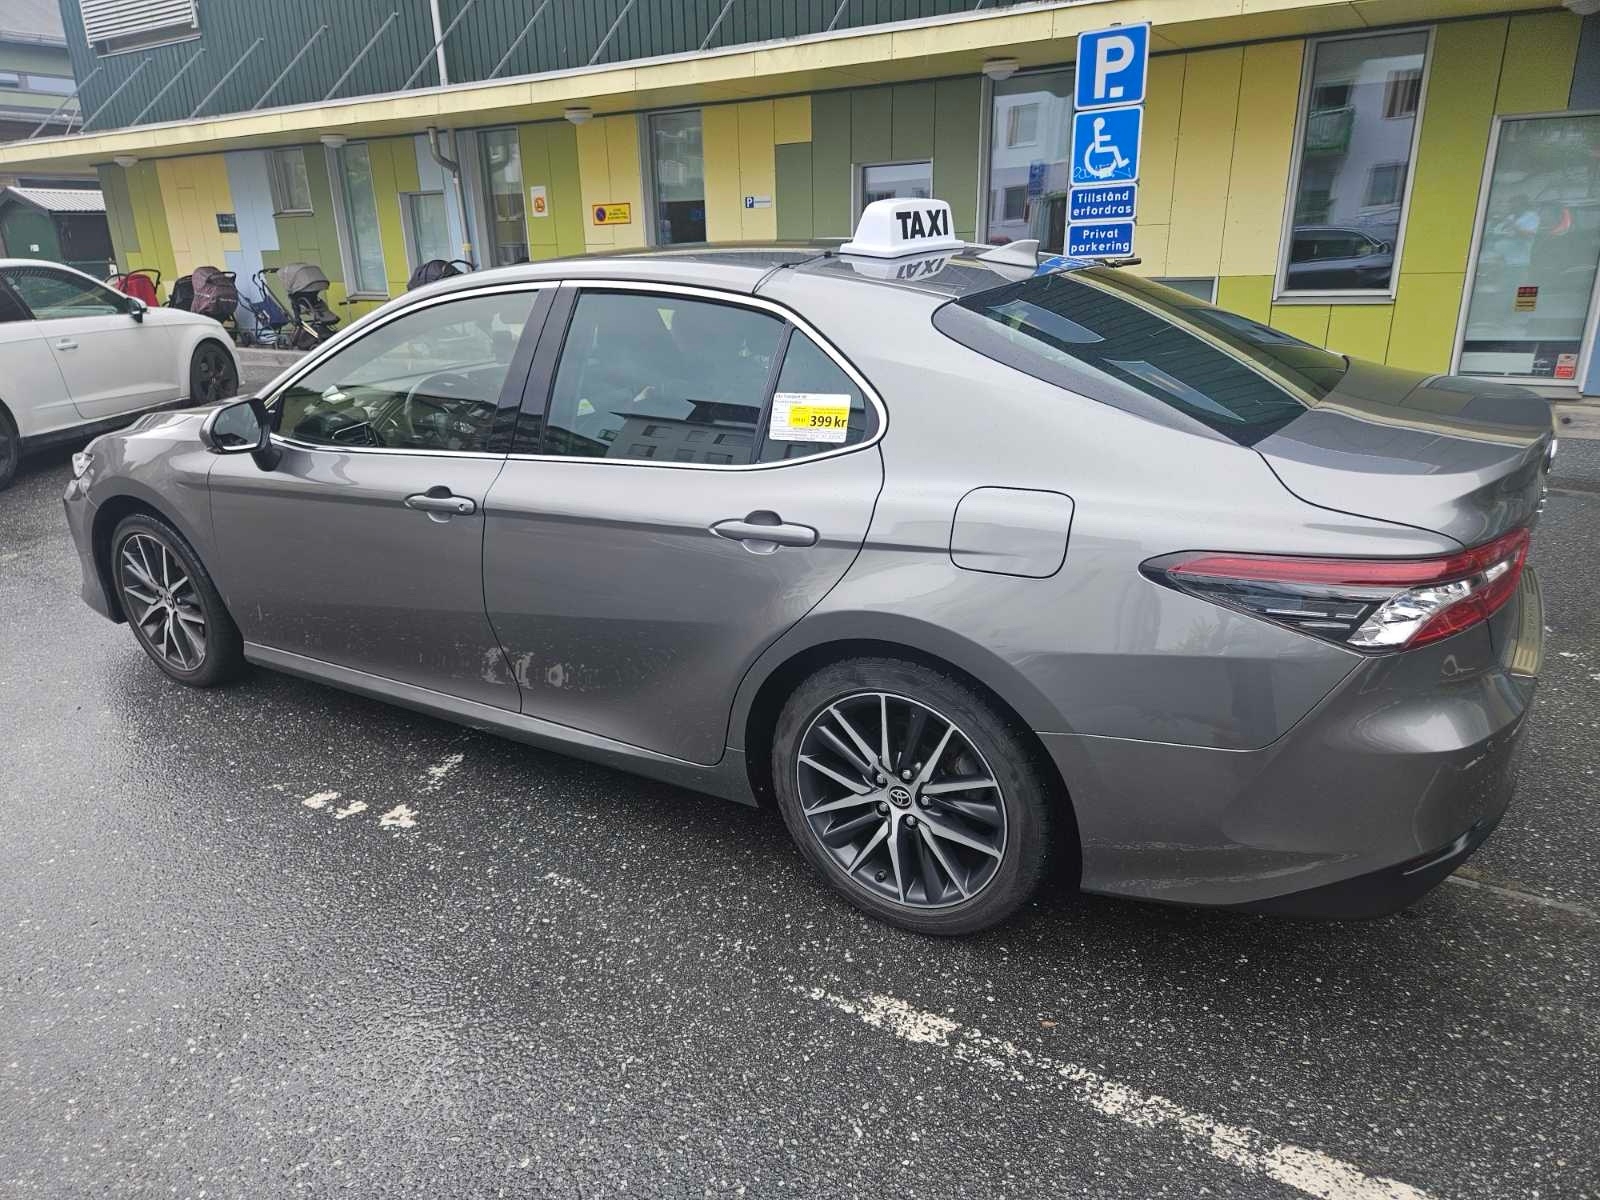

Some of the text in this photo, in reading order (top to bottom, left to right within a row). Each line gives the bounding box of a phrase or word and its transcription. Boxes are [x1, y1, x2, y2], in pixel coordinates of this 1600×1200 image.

[1077, 190, 1130, 204] Tillstånd
[1073, 205, 1132, 217] erfordras
[895, 209, 950, 240] TAXI
[1082, 228, 1119, 239] Privat
[1070, 240, 1130, 255] parkering
[810, 416, 832, 427] 399
[834, 416, 847, 428] kr
